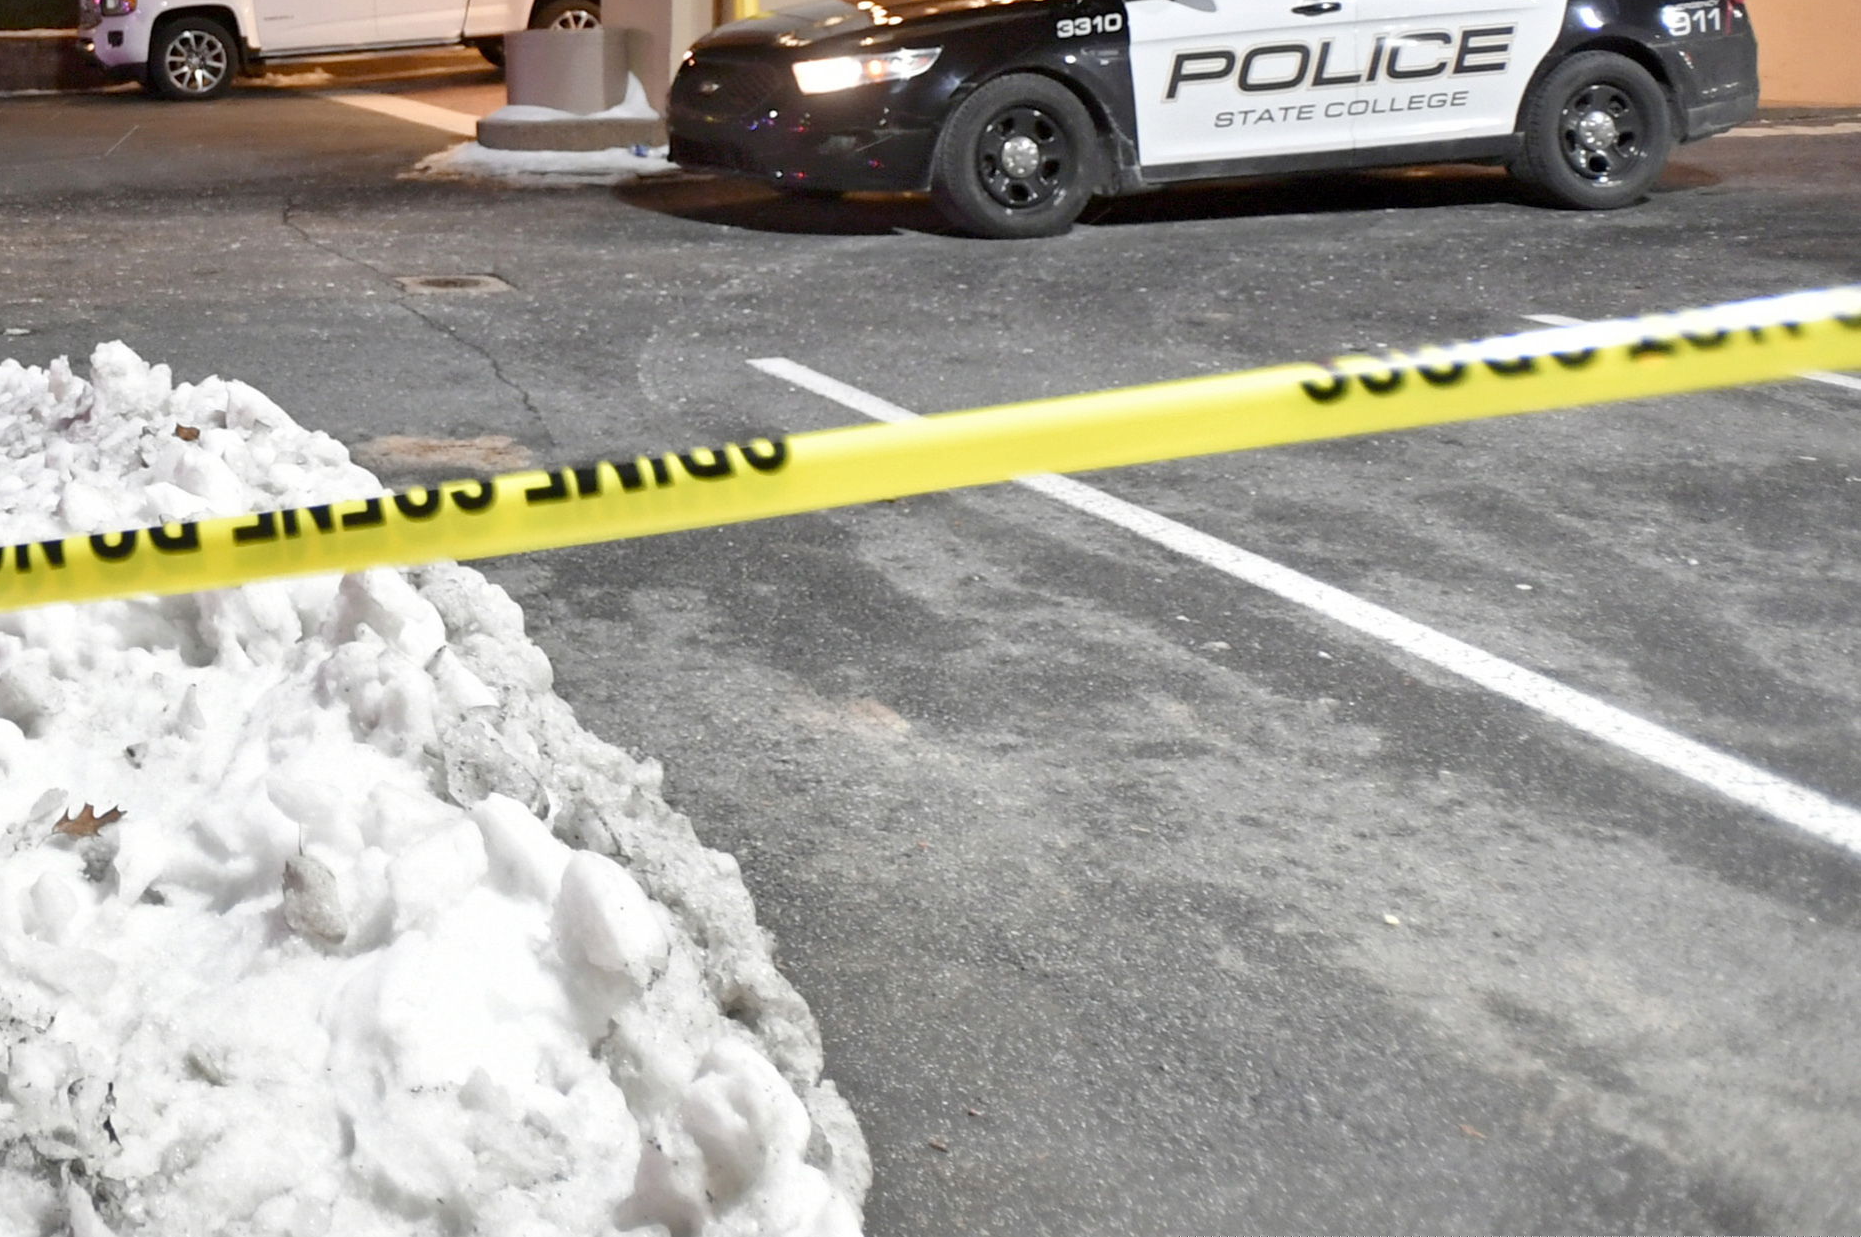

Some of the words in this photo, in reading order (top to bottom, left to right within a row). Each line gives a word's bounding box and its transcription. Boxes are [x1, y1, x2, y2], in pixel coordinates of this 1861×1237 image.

[1056, 12, 1122, 39] 3310
[1666, 7, 1720, 36] 911
[1162, 24, 1516, 102] POLICE
[1214, 104, 1316, 128] STATE
[1323, 90, 1469, 118] COLLEGE
